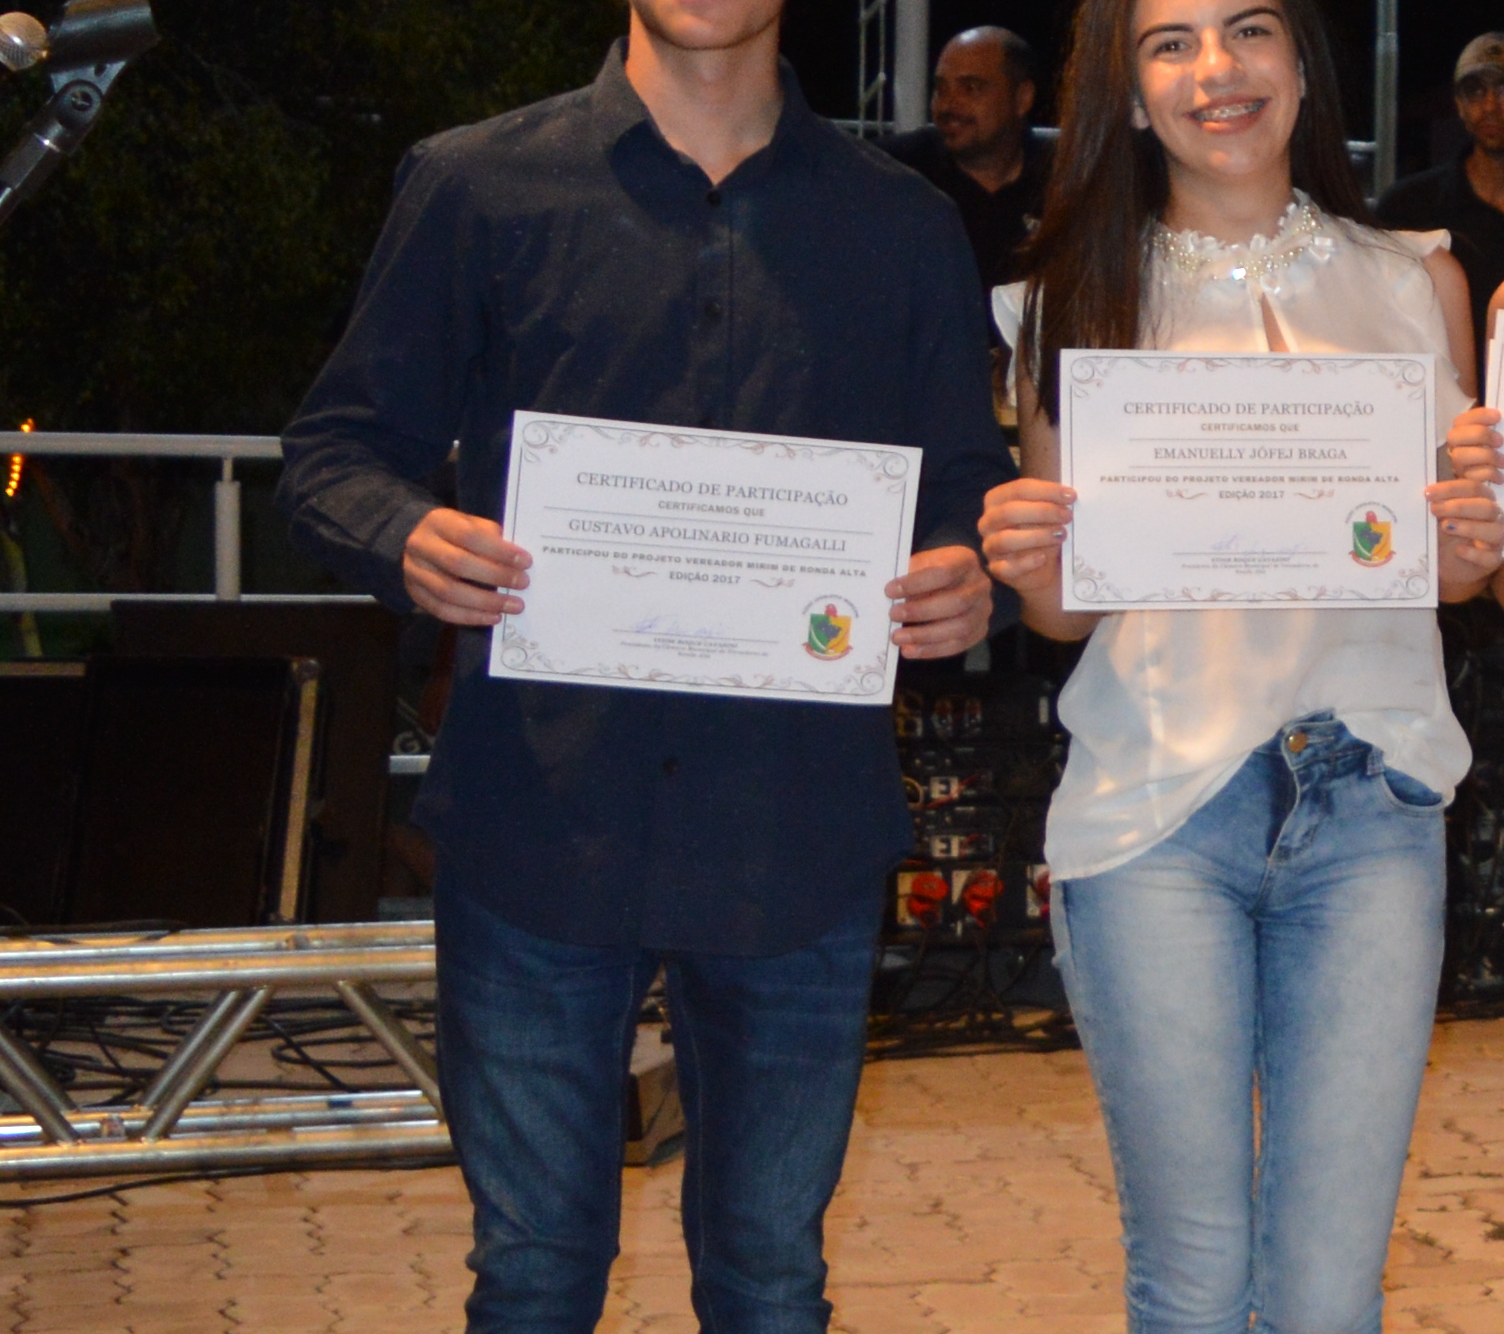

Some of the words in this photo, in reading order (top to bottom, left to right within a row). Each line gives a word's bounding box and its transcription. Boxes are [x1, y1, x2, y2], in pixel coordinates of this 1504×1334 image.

[1123, 401, 1231, 415] CERTIFICADO
[1235, 402, 1257, 415] DE
[1261, 400, 1375, 418] PARTICIPAÇÃO
[1200, 422, 1277, 432] CERTIFICAMOS
[1279, 423, 1300, 433] QUE
[1153, 447, 1245, 460] EMANUELLY
[1298, 448, 1347, 460] BRAGA
[576, 471, 694, 494] CERTIFICADO
[697, 482, 721, 496] DE
[725, 484, 849, 507] PARTICIPAÇÃO
[1218, 489, 1256, 501] EDIÇÃO
[1258, 490, 1285, 500] 2017
[657, 500, 740, 515] CERTIFICAMOS
[743, 506, 765, 518] QUE
[568, 518, 646, 536] GUSTAVO
[754, 533, 846, 552] FUMAGALLI
[668, 570, 710, 583] EDIÇÃO
[711, 573, 741, 585] 2017
